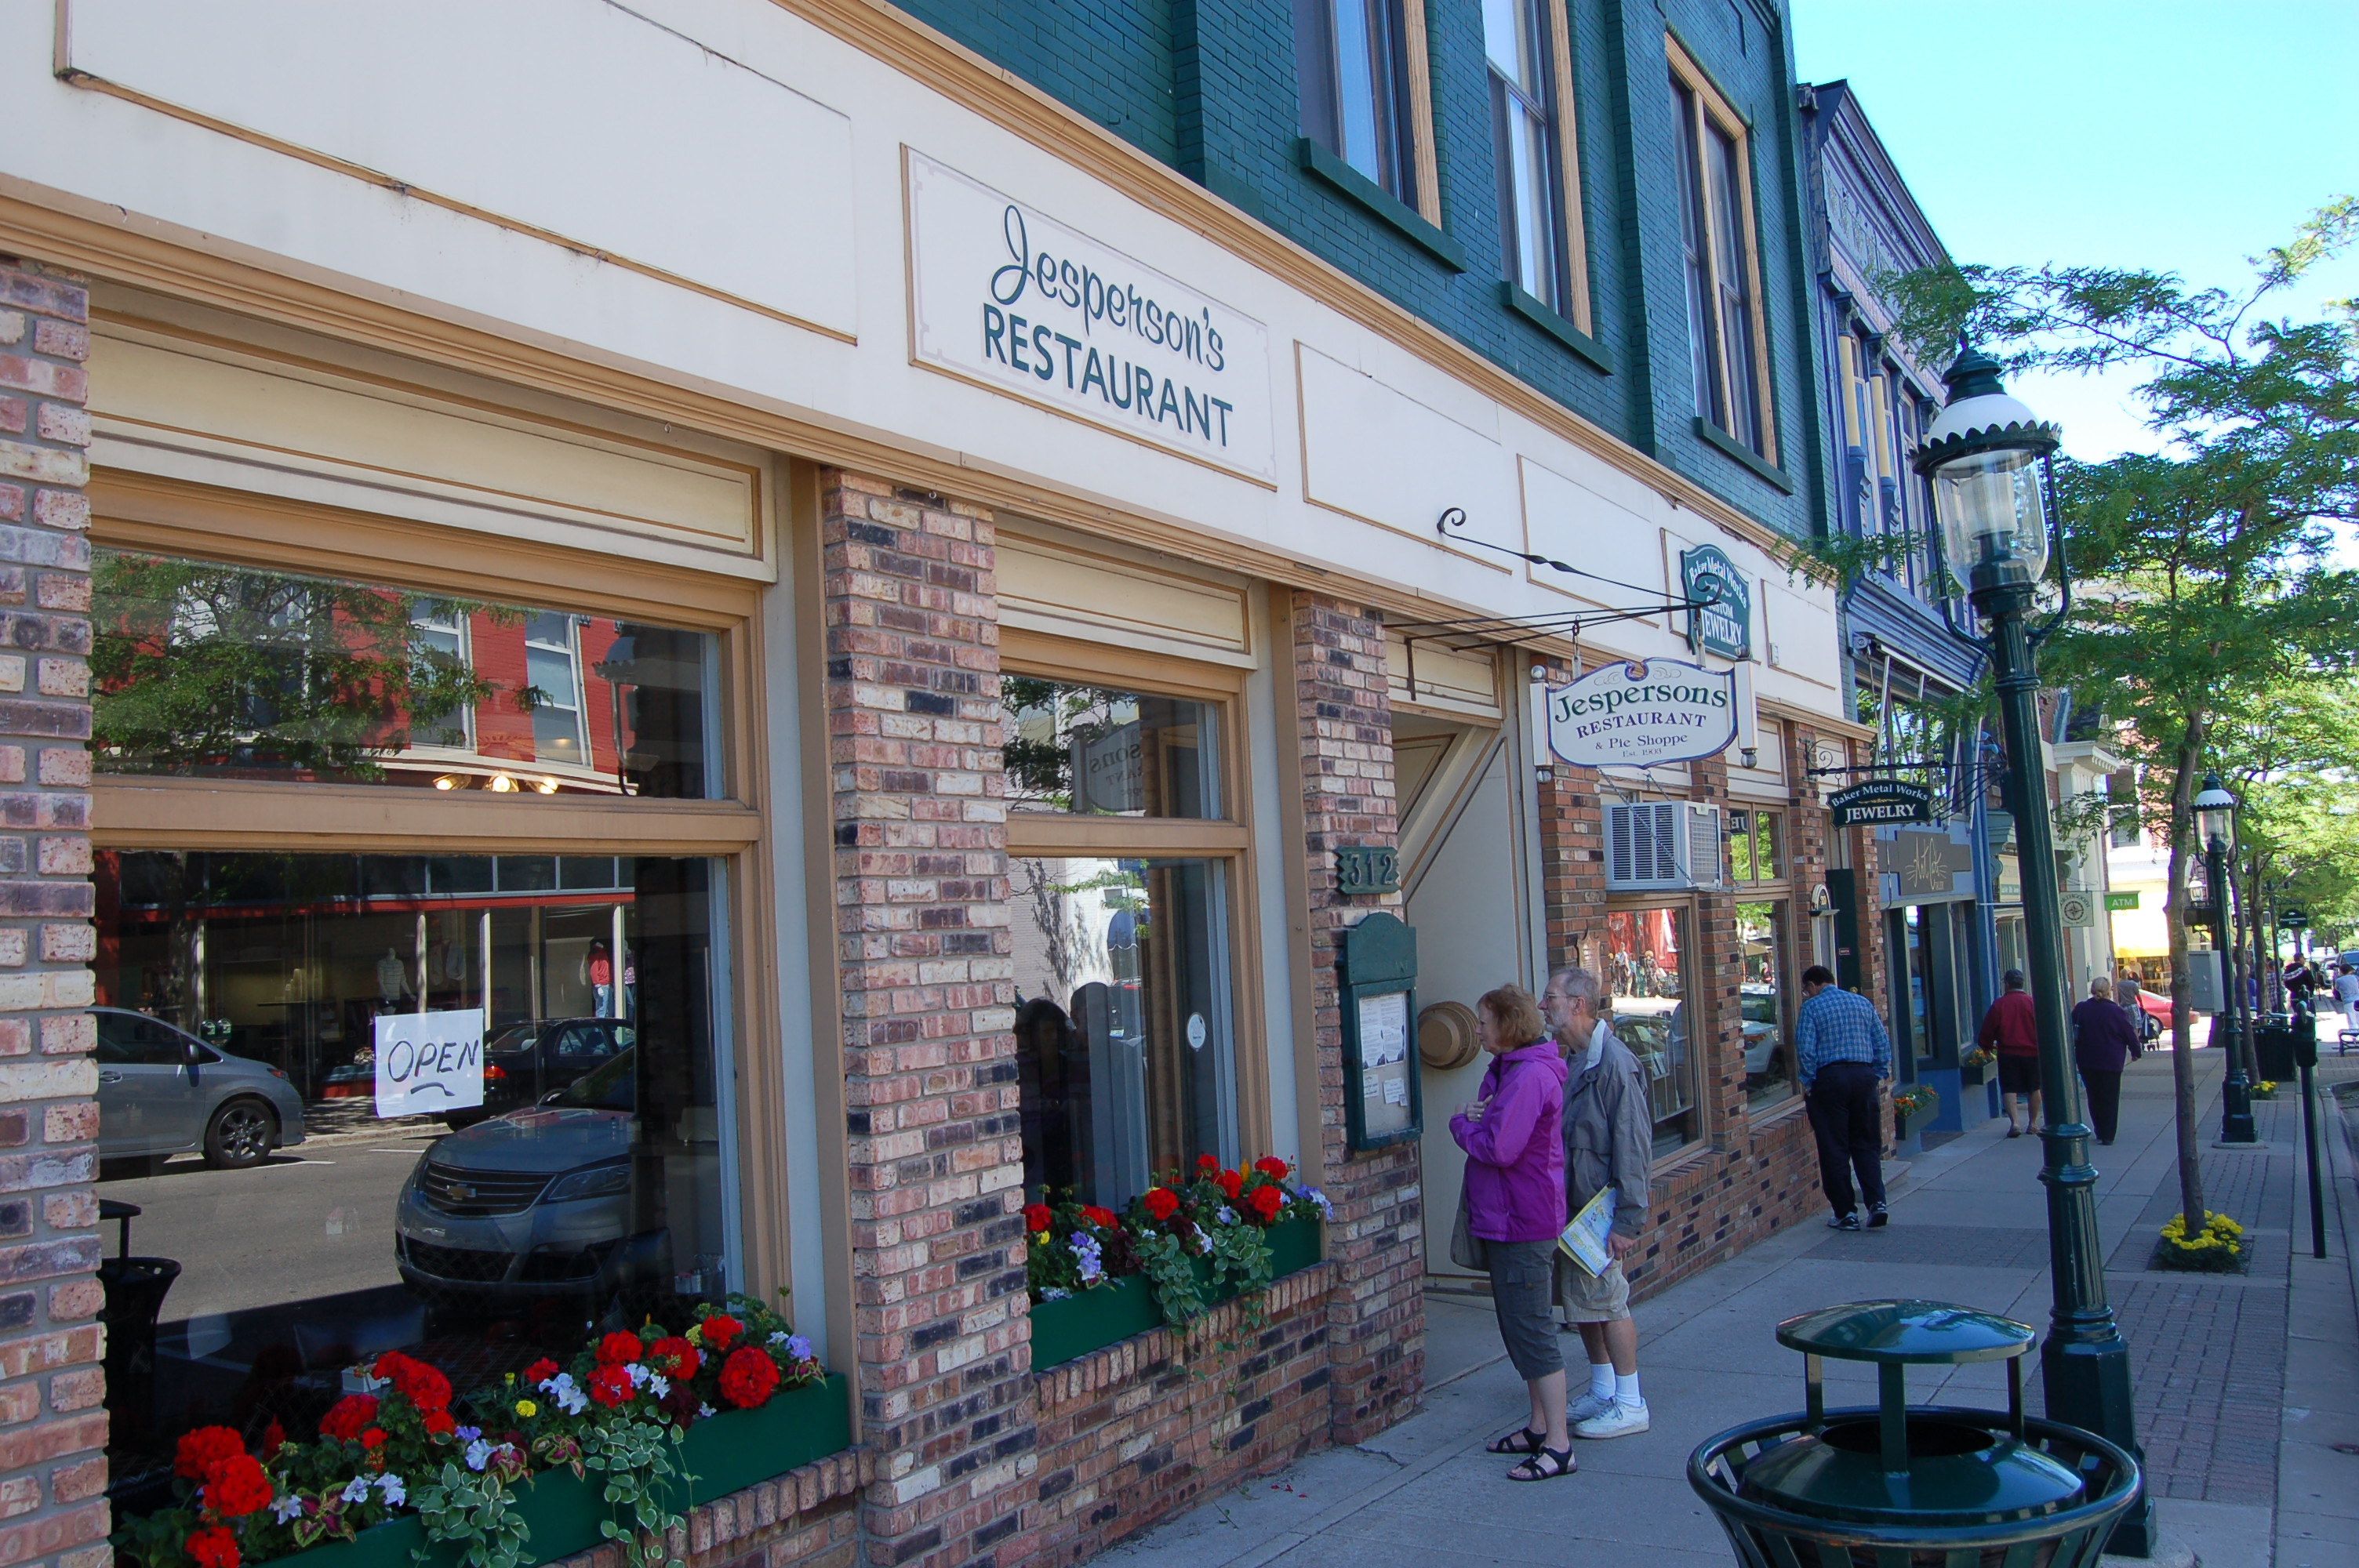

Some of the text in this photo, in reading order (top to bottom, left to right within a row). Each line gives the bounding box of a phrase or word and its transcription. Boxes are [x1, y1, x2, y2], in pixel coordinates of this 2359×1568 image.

[990, 205, 1225, 372] Jesperson's
[983, 303, 1233, 447] RESTAURANT
[1688, 556, 1747, 609] Baker Metal Works
[1696, 608, 1743, 646] JEWELRY
[1554, 684, 1728, 723] Jespersons
[1576, 712, 1707, 739] RESTAURANT
[1595, 734, 1688, 750] & Pie Shoppe
[1831, 784, 1928, 807] Baker Metal Works
[1845, 804, 1916, 823] JEWELRY
[1348, 851, 1394, 885] 312
[2112, 898, 2133, 907] ATM
[388, 1040, 479, 1082] OPEN
